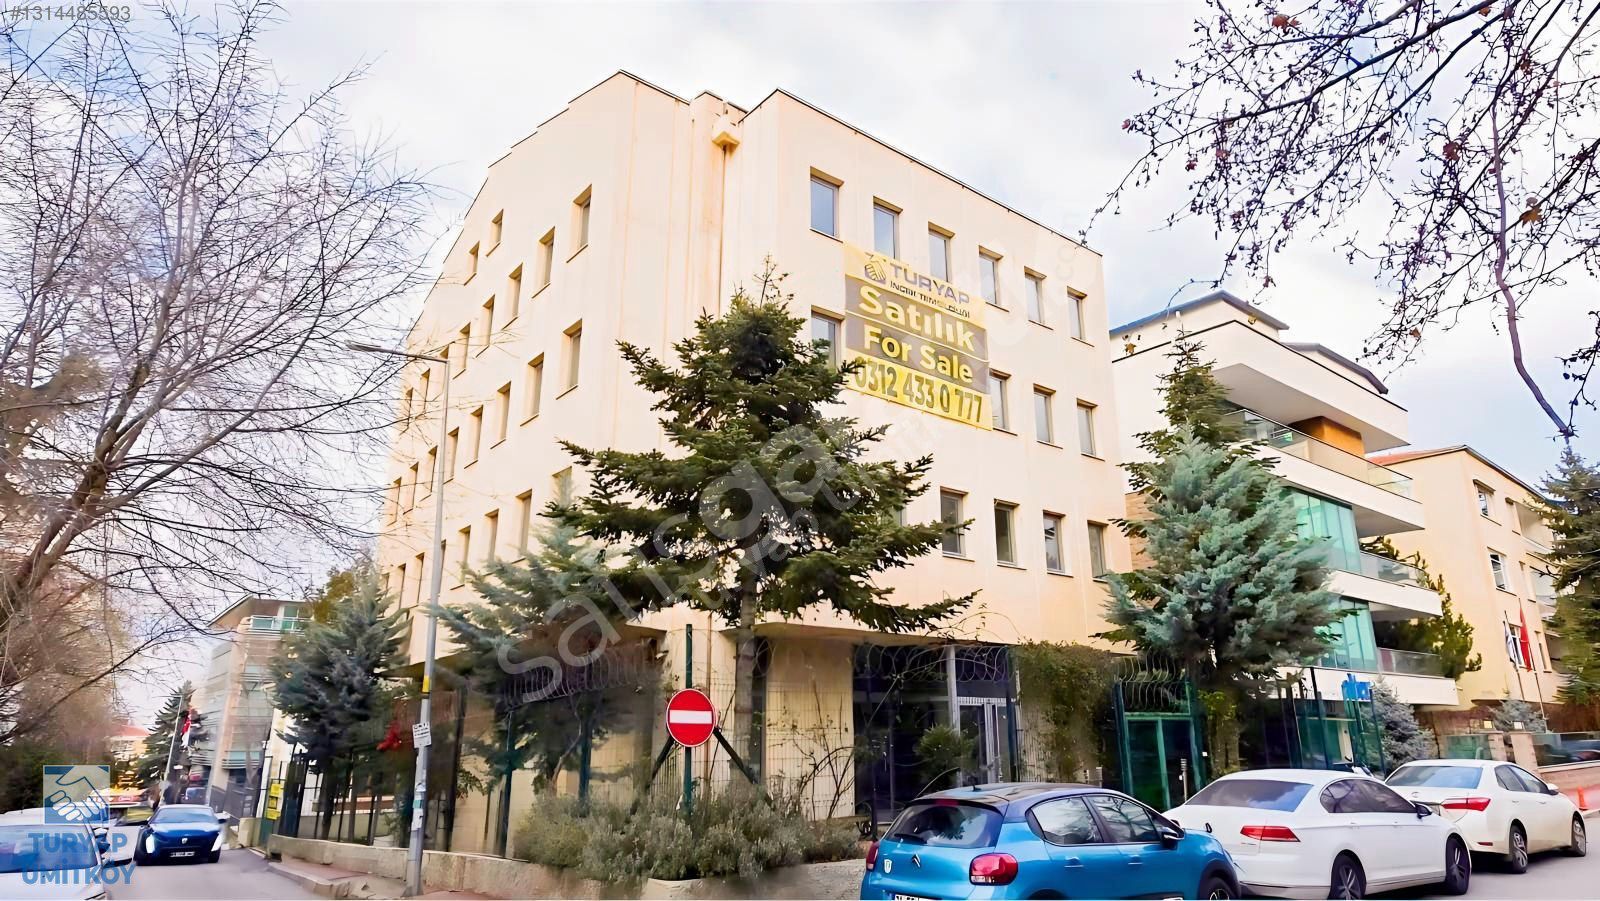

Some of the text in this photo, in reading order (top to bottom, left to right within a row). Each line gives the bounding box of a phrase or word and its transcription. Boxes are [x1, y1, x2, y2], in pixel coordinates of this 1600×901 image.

[890, 262, 970, 304] TURYAP
[859, 285, 975, 353] Satılık
[864, 323, 974, 383] For Sale
[855, 357, 983, 423] 0312 433 0 777
